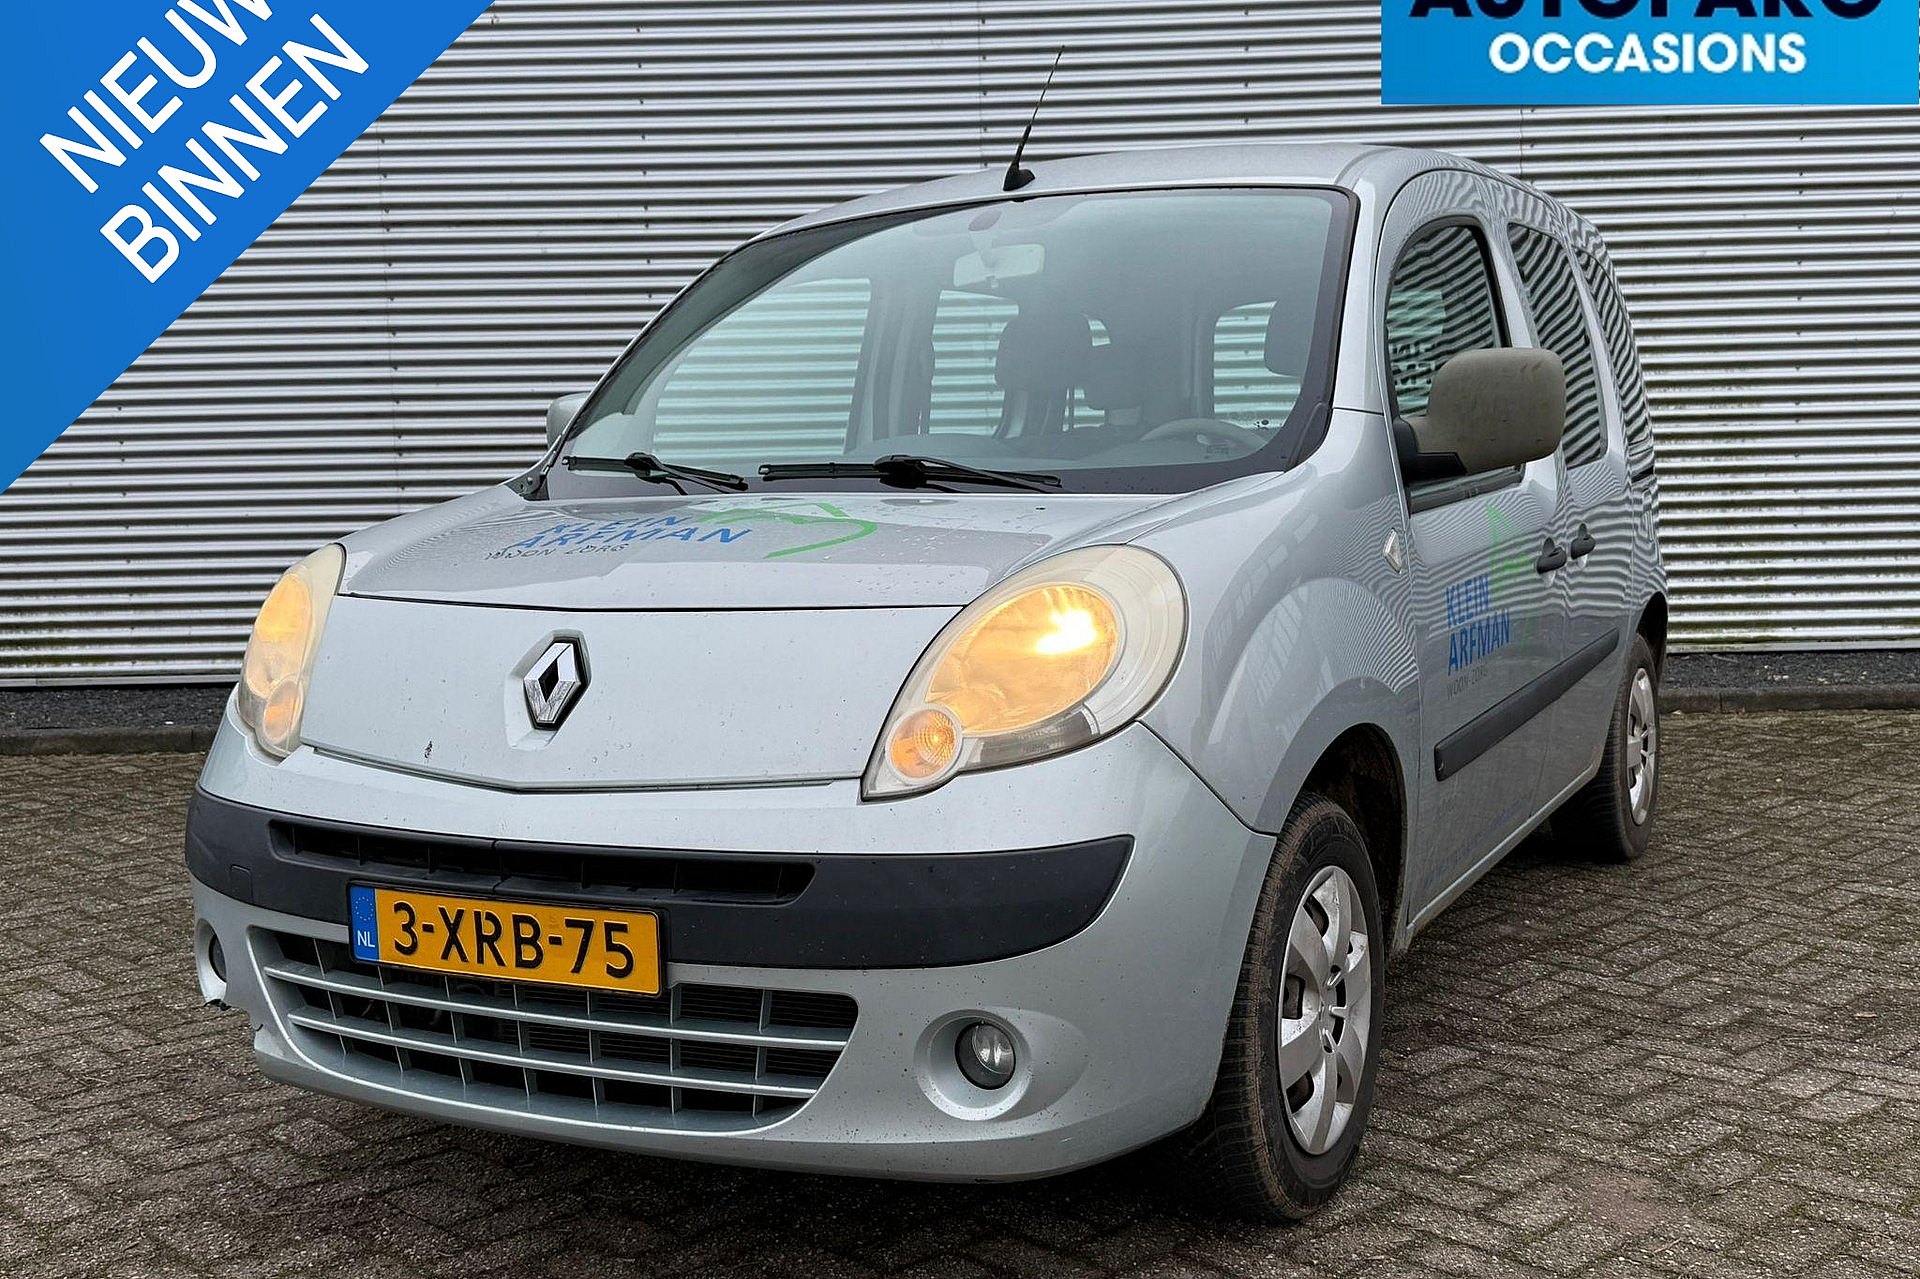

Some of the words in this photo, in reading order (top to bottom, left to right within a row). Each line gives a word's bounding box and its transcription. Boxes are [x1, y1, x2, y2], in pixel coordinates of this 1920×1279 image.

[501, 527, 752, 553] ARFMAN
[537, 515, 694, 536] KLEIN
[1446, 573, 1490, 627] KLEIN
[1448, 609, 1510, 675] ARFMAN
[357, 930, 376, 948] NL
[393, 901, 634, 979] 3-XRB-75
